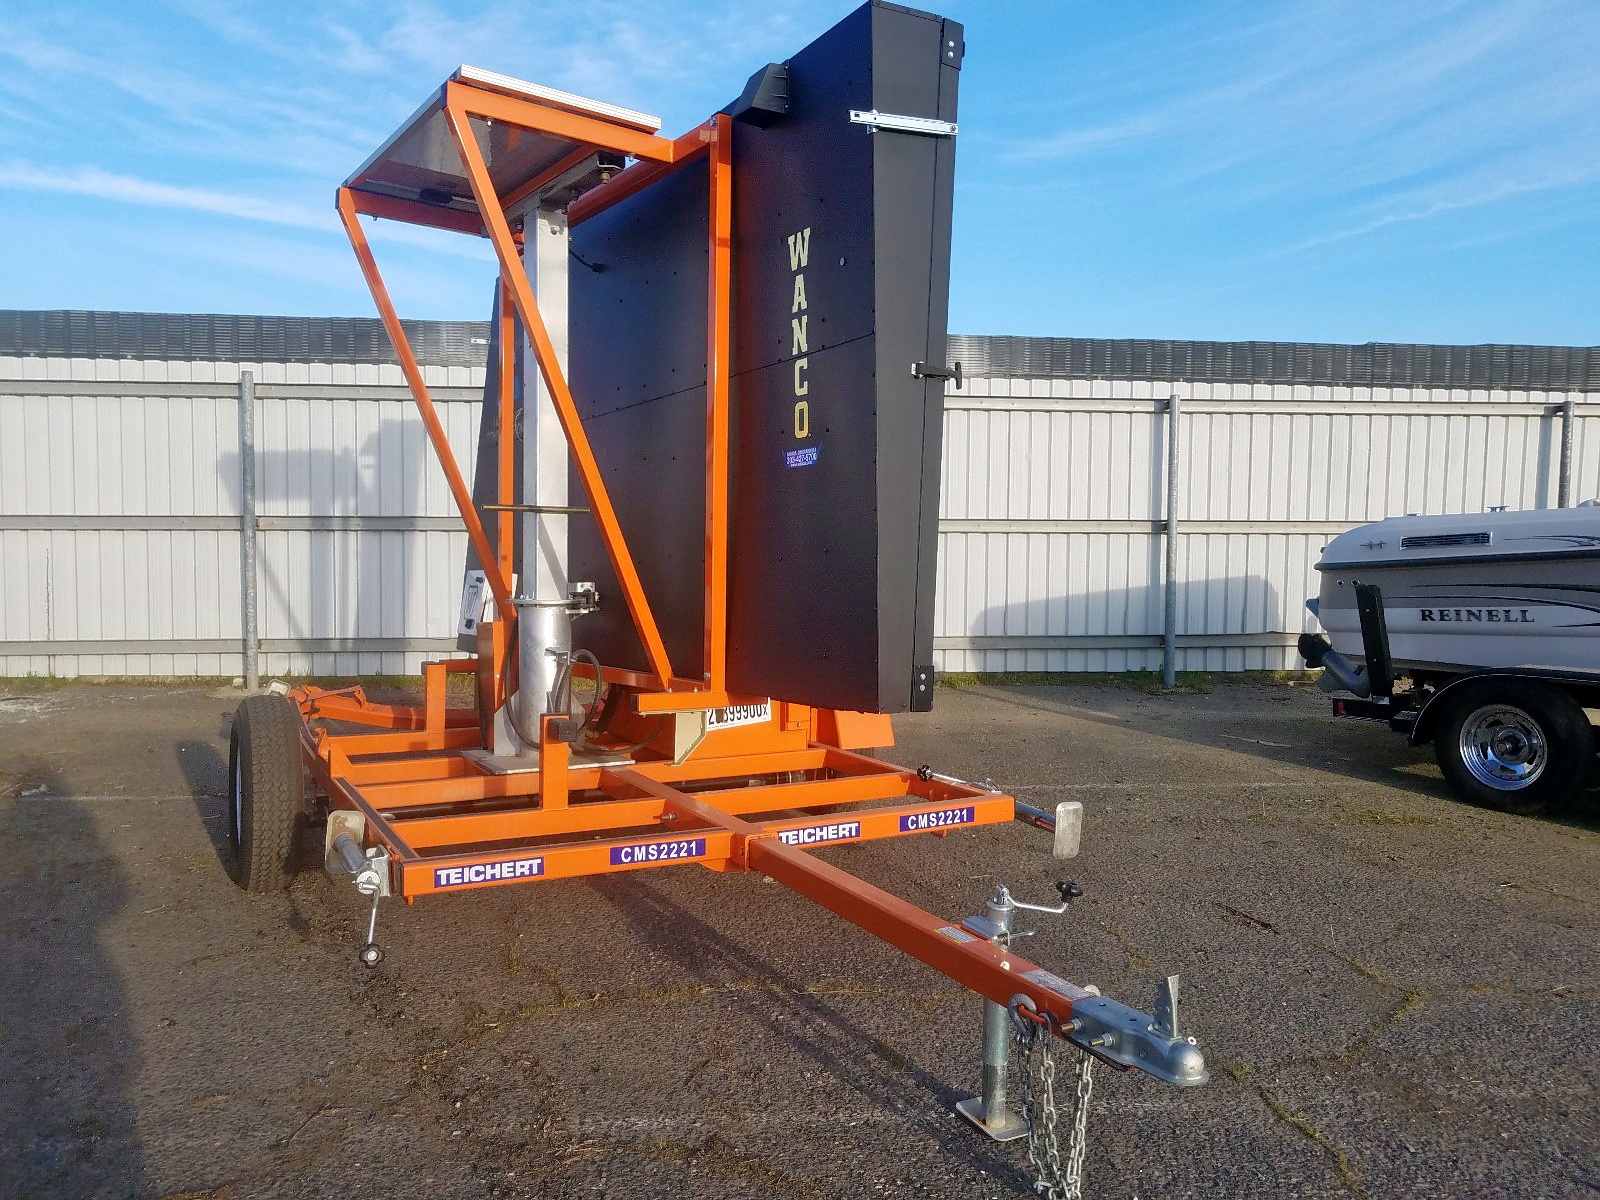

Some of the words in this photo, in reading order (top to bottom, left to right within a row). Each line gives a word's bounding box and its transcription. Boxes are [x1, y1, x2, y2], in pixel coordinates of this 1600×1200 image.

[787, 227, 811, 439] WANCO
[1419, 609, 1535, 623] REINELL
[907, 808, 968, 829] CMS2221
[779, 822, 859, 846] TEICHERT
[620, 840, 698, 863] CMS2221
[437, 858, 542, 886] TEICHERT
